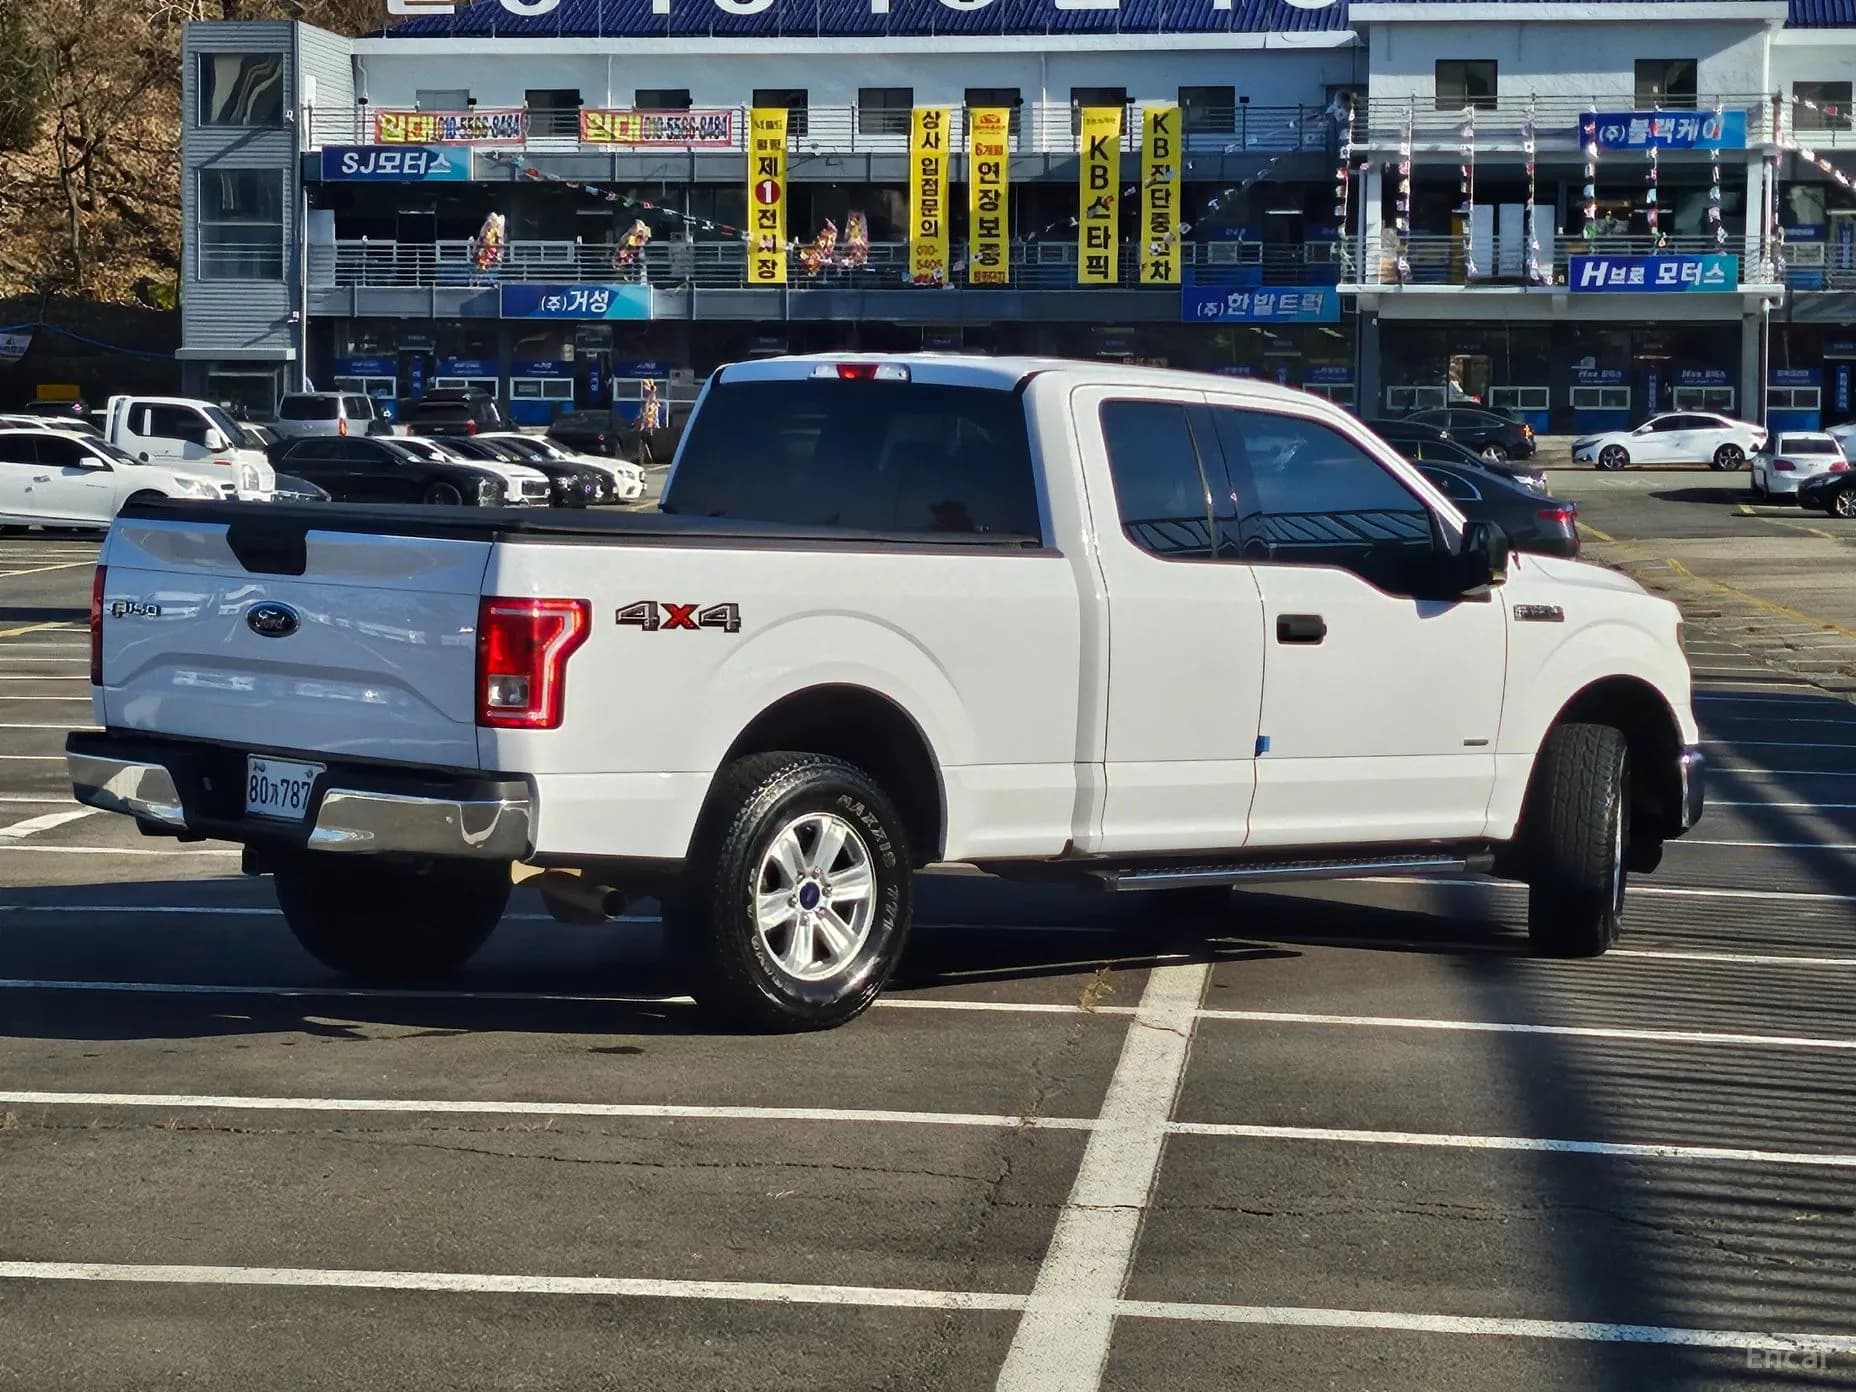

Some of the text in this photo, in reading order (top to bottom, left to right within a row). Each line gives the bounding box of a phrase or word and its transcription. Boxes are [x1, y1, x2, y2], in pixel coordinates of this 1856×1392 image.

[921, 111, 941, 150] 상사
[341, 152, 452, 175] SJ모터스
[977, 162, 1002, 266] 연장보증
[1655, 262, 1725, 286] 모터스
[541, 290, 609, 313] (주)거성
